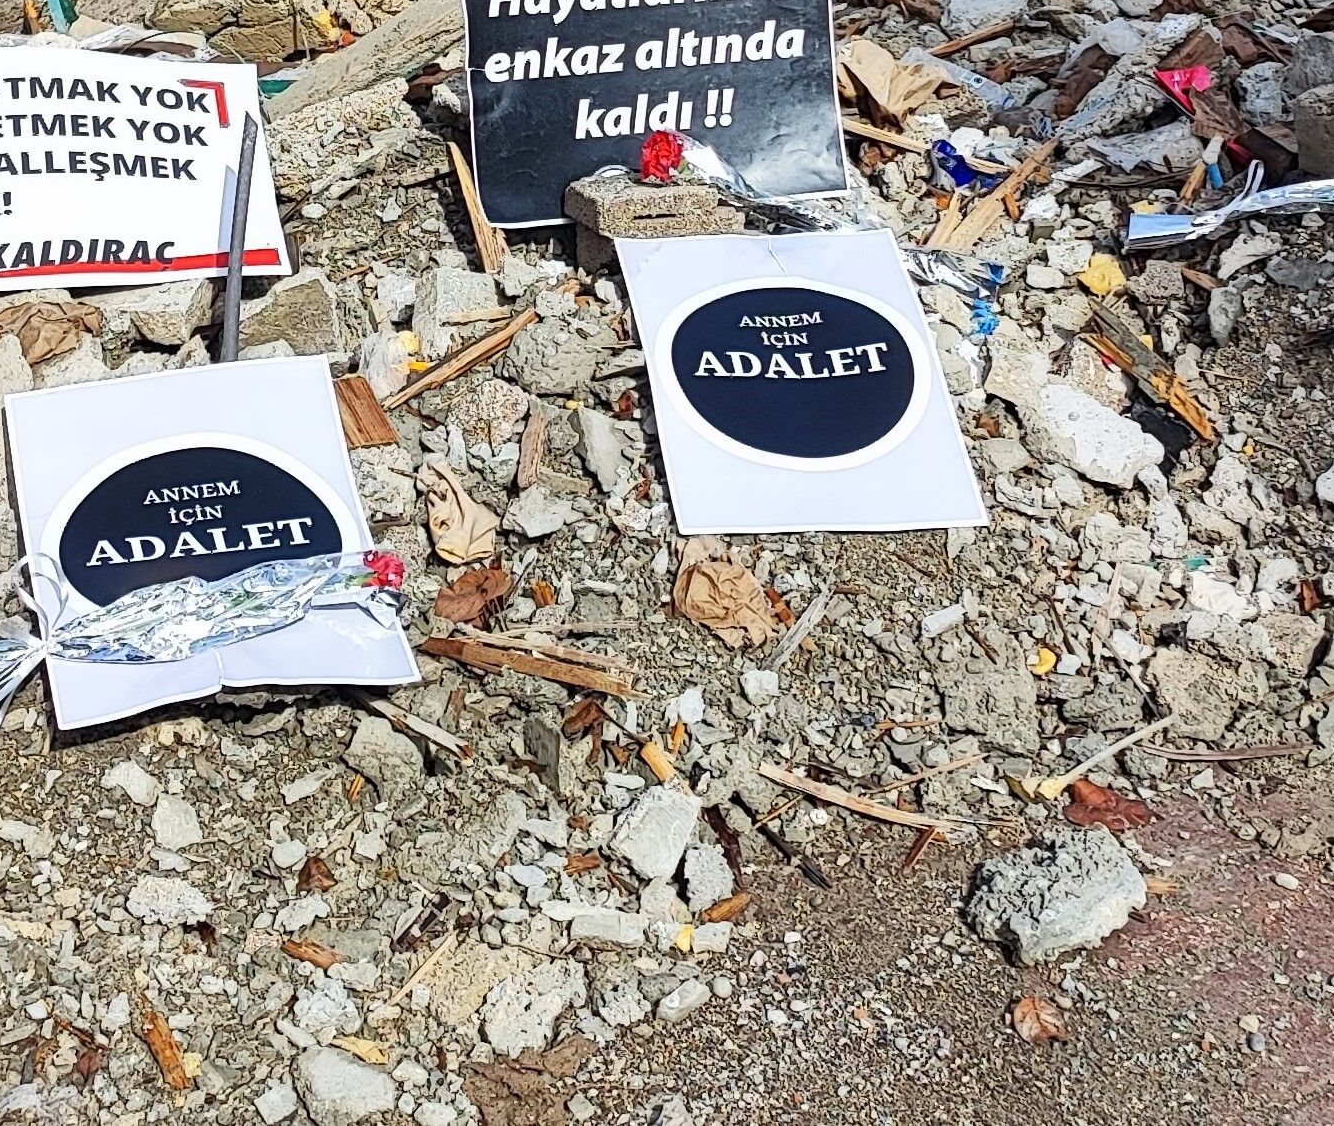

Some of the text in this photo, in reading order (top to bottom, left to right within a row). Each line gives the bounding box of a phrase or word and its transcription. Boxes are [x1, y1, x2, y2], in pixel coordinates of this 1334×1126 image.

[484, 20, 806, 83] enkaz altında
[131, 84, 211, 114] YOK
[575, 87, 735, 140] kaldı !!
[127, 118, 209, 147] YOK
[738, 311, 824, 328] ANNEM
[761, 331, 808, 349] İÇİN
[693, 342, 889, 380] ADALET
[143, 479, 241, 505] ANNEM
[168, 504, 223, 526] İÇİN
[85, 516, 313, 567] ADALET
